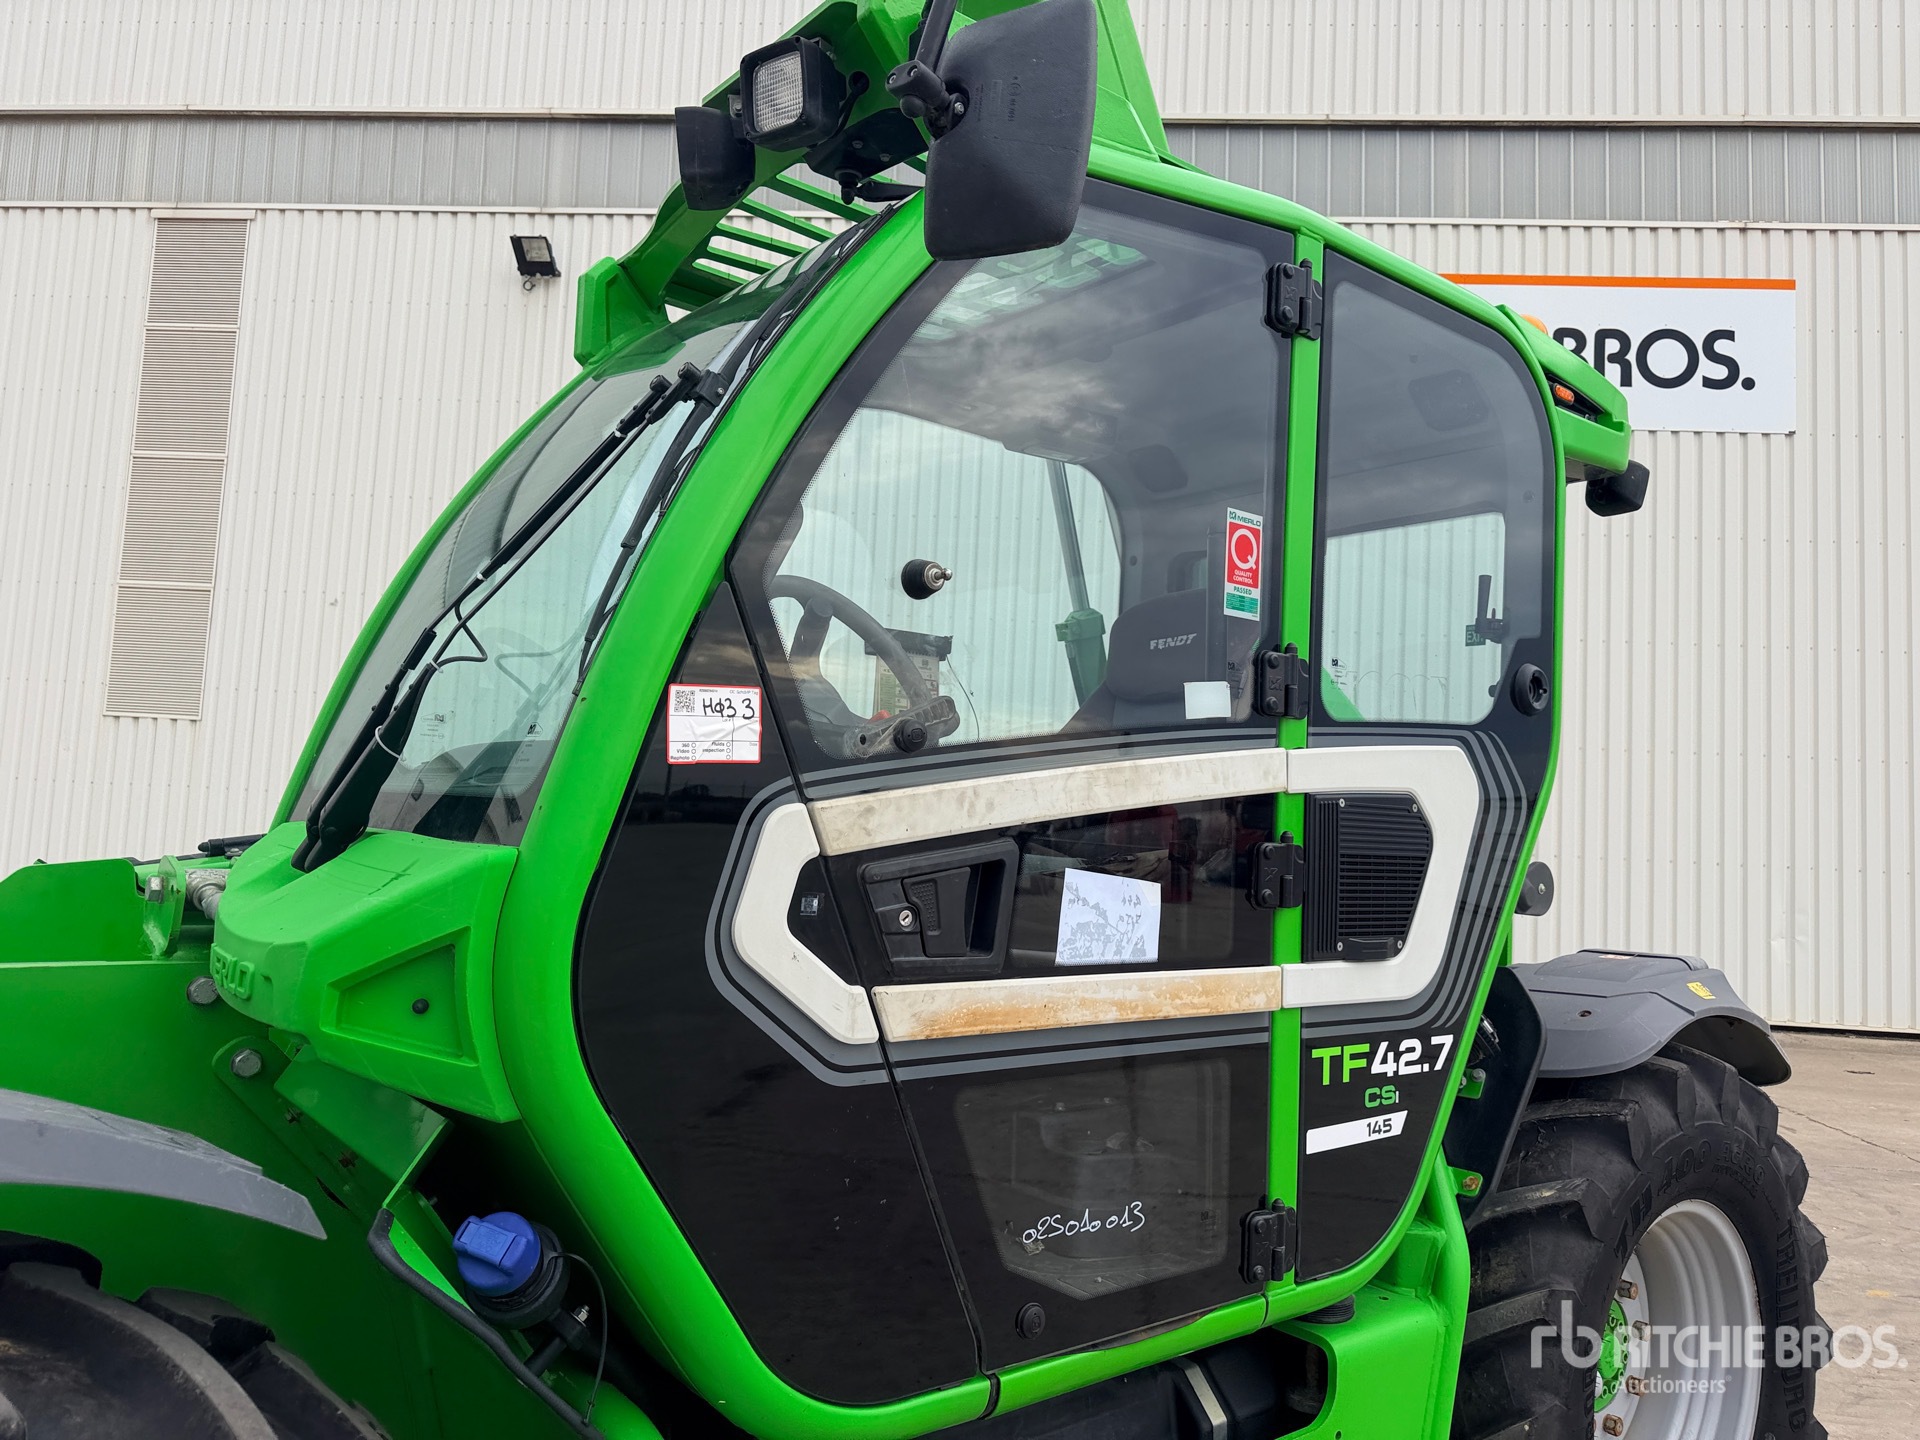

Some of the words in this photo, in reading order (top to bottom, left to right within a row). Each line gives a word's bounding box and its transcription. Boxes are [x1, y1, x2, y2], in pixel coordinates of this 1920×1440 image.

[1234, 569, 1253, 578] QUALITY
[1233, 575, 1254, 585] CONTROL
[1233, 585, 1253, 596] PASSED
[1149, 633, 1197, 650] FENDT
[1466, 631, 1485, 643] EXI
[1366, 1118, 1392, 1137] 145
[1775, 1217, 1807, 1433] TRELLORG
